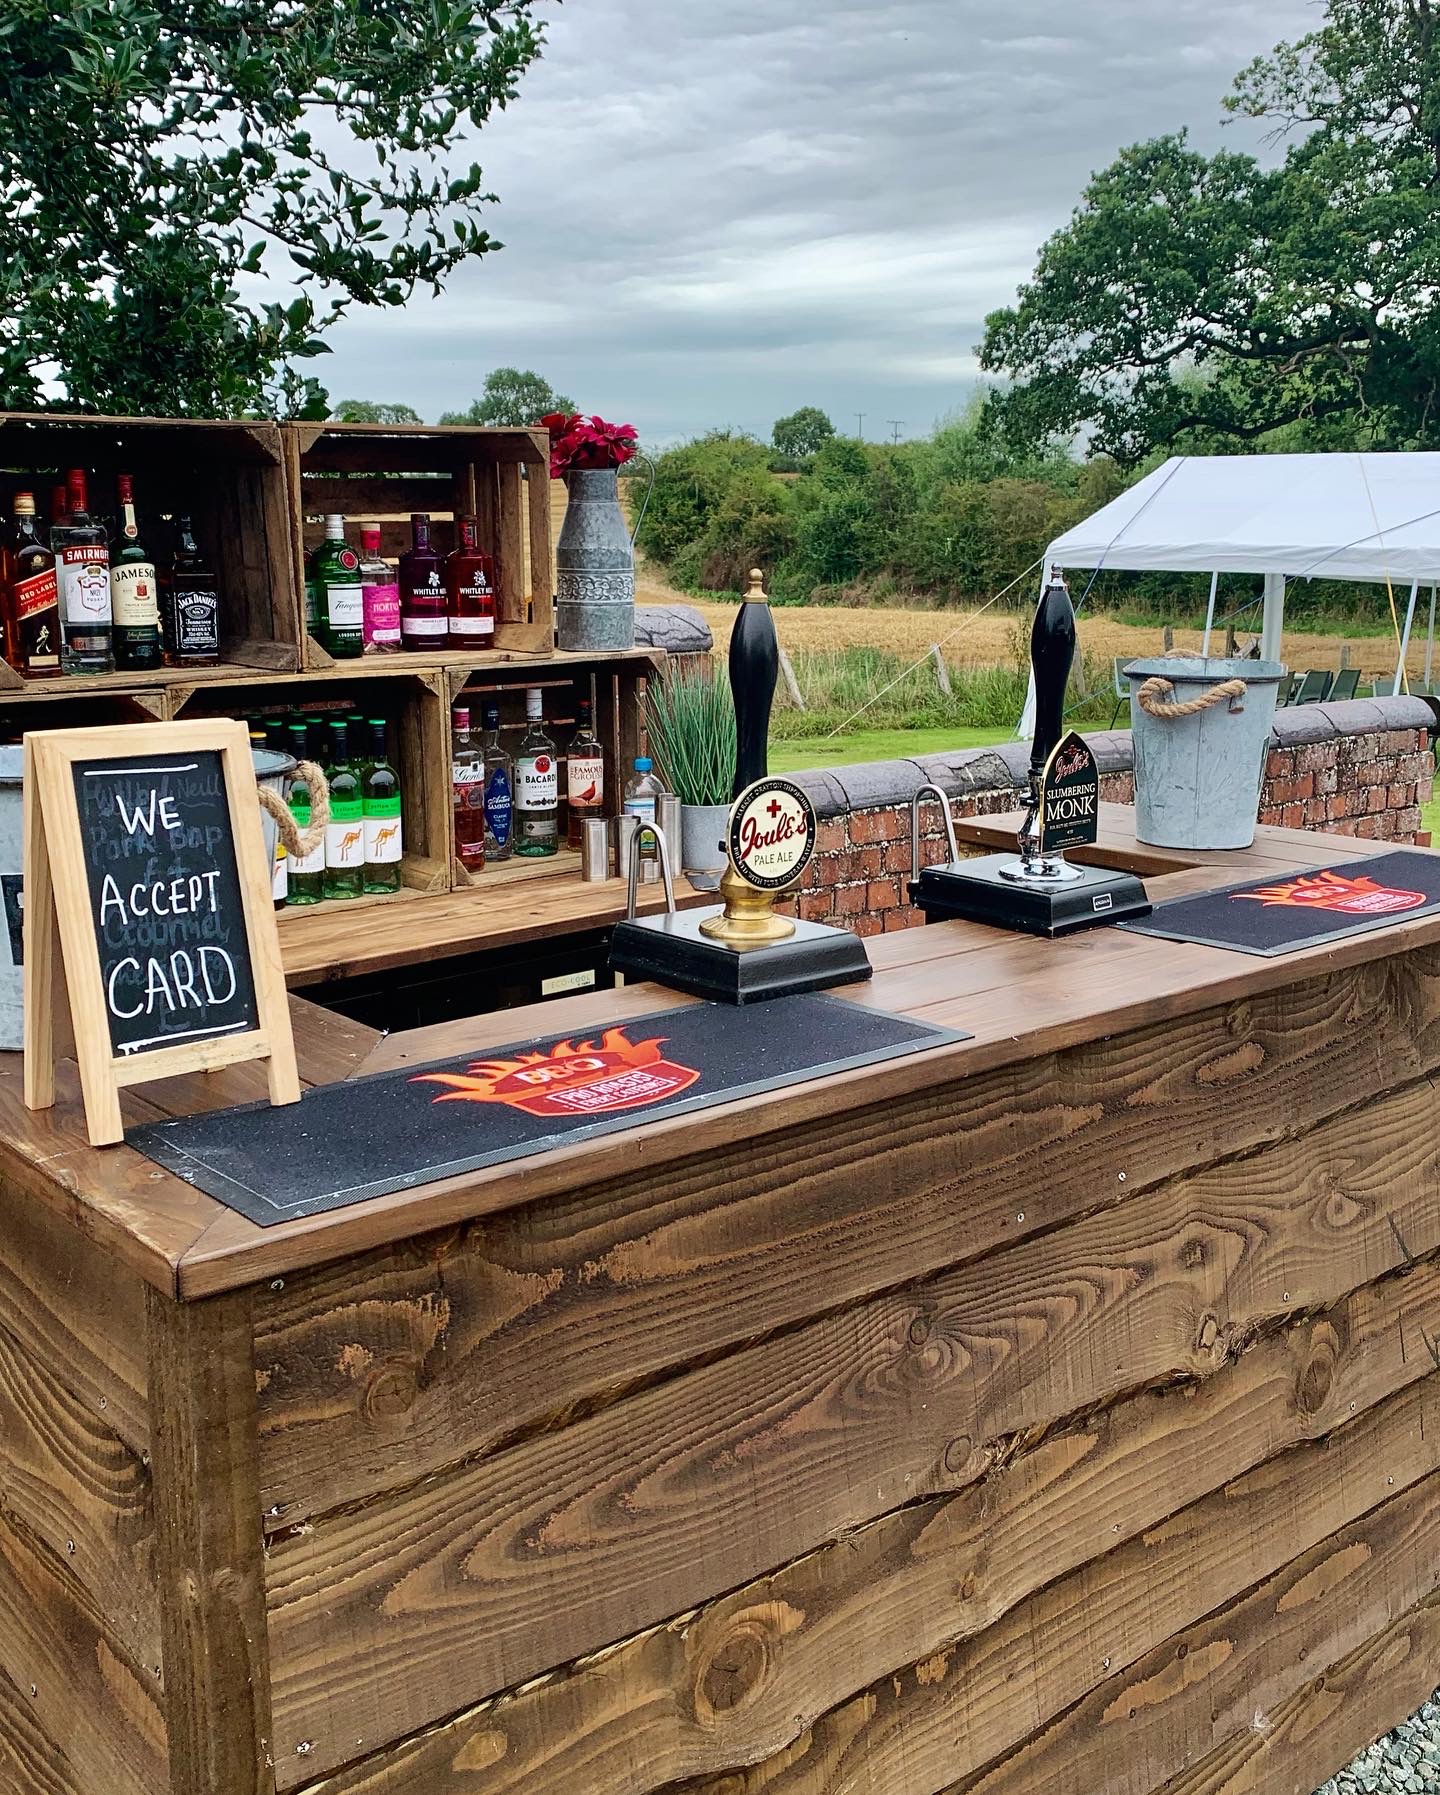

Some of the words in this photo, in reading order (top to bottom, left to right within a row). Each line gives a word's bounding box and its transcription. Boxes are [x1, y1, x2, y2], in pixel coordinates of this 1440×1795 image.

[115, 568, 155, 582] JAMESO
[20, 590, 35, 601] RED
[35, 581, 57, 594] LABEL
[413, 587, 439, 595] WHITLEY
[459, 587, 485, 595] WHITLEY
[178, 595, 194, 609] JACK
[373, 602, 399, 612] HORTU
[525, 774, 555, 784] BACARD
[1046, 783, 1096, 800] SLUMBERING
[116, 789, 181, 836] WE
[1046, 795, 1095, 821] MONK
[754, 853, 775, 866] PALE
[776, 851, 793, 863] ALE
[100, 870, 221, 926] ACCEPT
[108, 946, 236, 1019] CARD
[513, 1058, 607, 1084] BBQ
[560, 1089, 600, 1102] PRO
[590, 1073, 652, 1095] ROASTS
